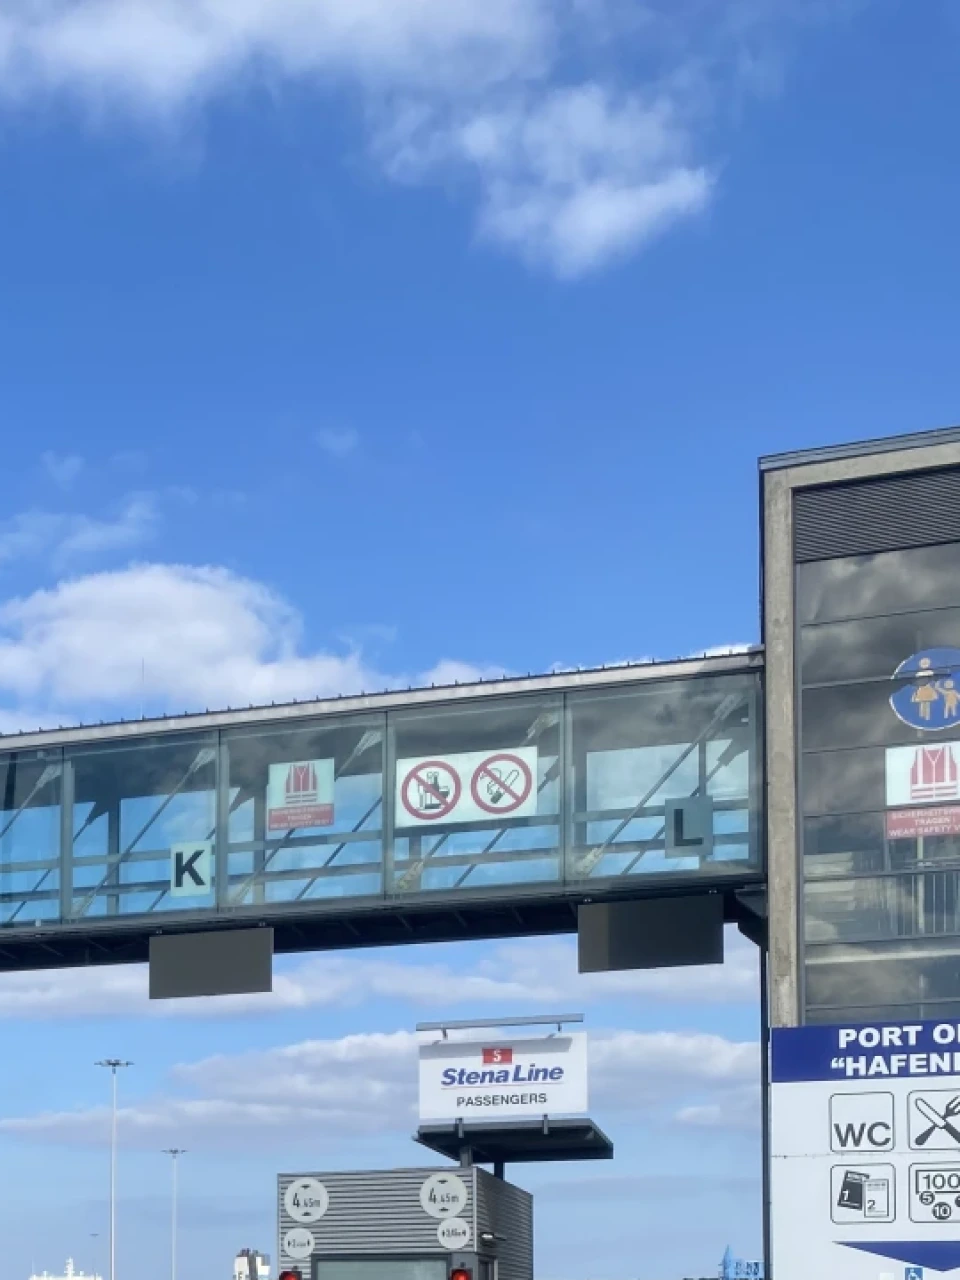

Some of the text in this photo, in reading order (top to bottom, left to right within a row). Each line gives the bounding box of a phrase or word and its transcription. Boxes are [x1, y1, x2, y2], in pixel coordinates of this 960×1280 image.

[674, 808, 704, 846] L
[174, 849, 206, 887] K
[838, 1023, 960, 1049] PORT O
[441, 1063, 564, 1086] Stena Line
[456, 1092, 547, 1107] PASSENGERS
[833, 1121, 891, 1147] WC
[922, 1172, 960, 1190] 100
[921, 1191, 933, 1204] 5
[936, 1203, 950, 1217] 10
